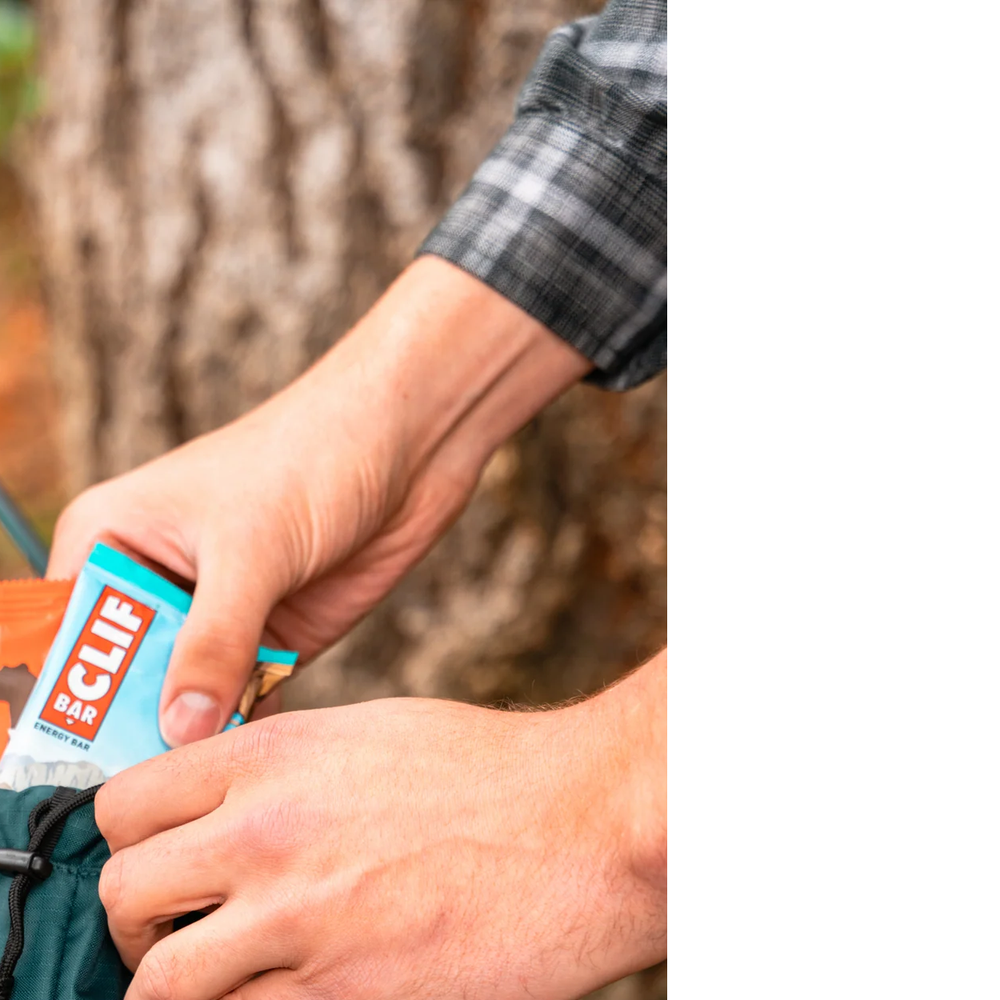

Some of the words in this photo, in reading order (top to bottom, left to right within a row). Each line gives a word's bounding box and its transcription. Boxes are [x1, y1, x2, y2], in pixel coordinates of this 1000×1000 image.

[67, 595, 143, 701] CLIF
[53, 692, 98, 725] BAR
[33, 721, 70, 743] ENERGY
[71, 738, 92, 752] BAR
